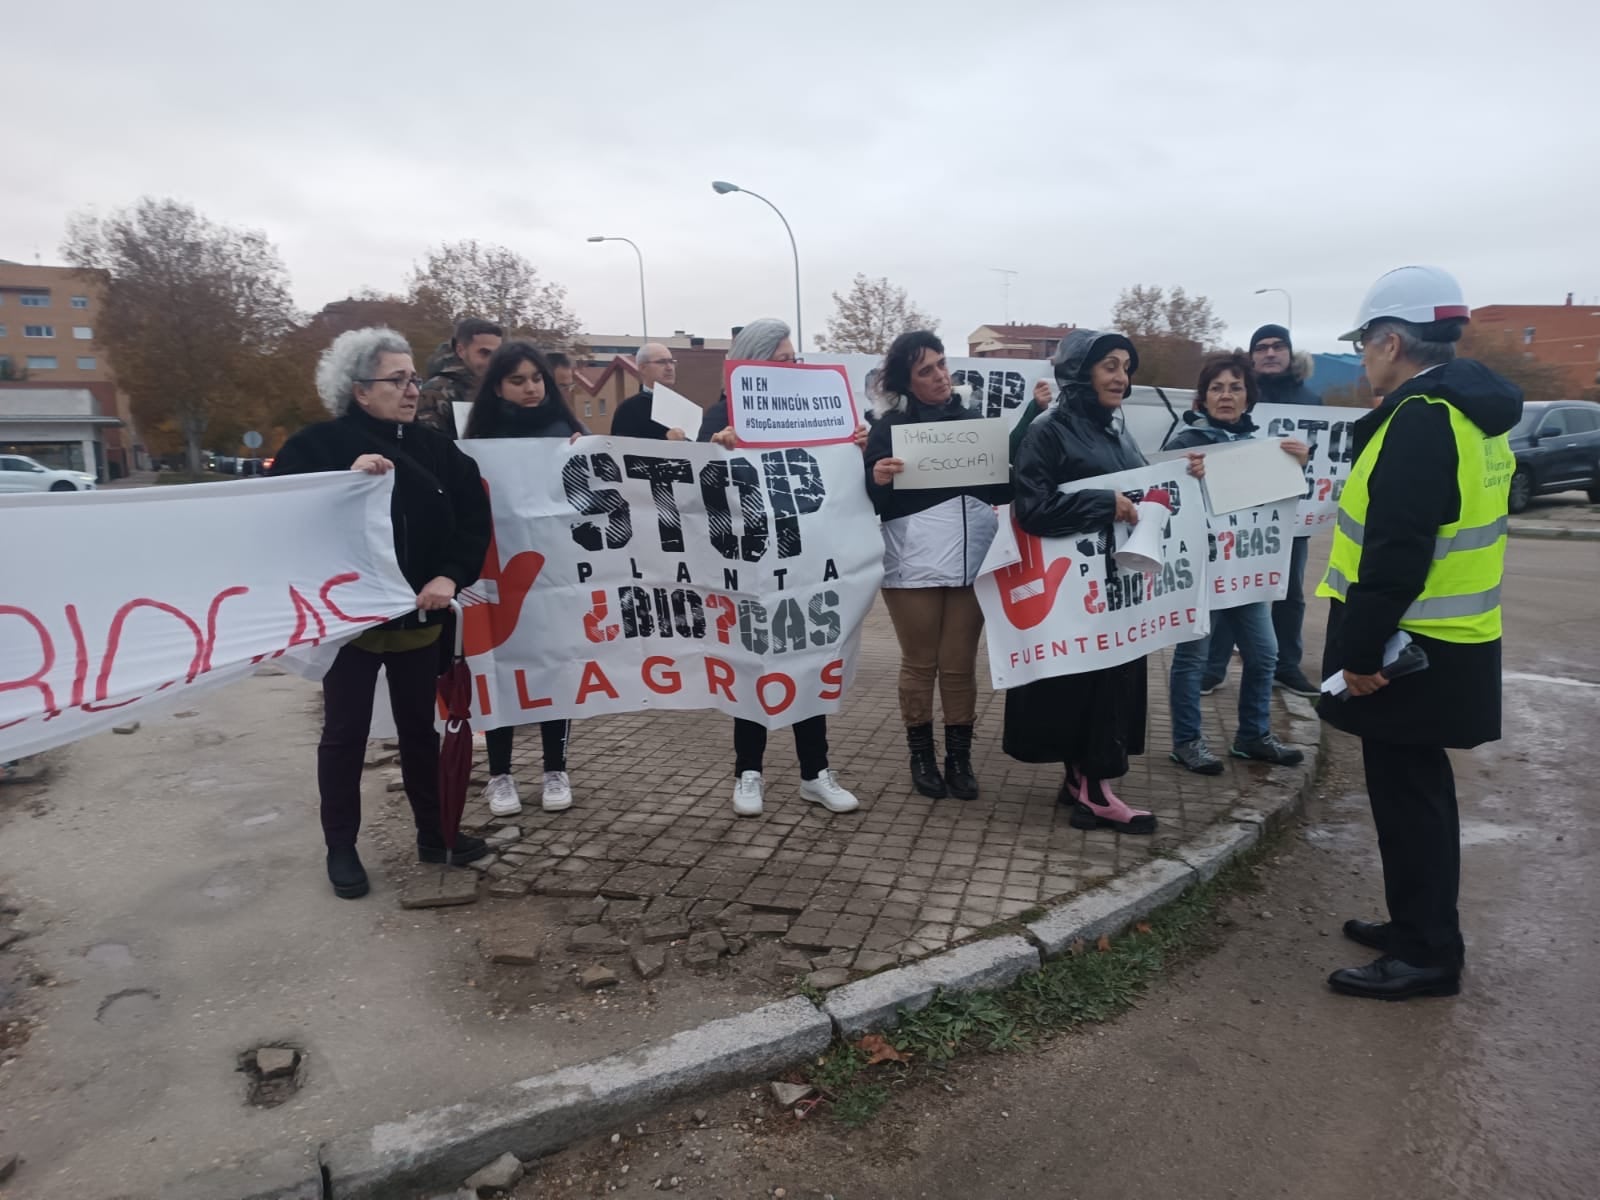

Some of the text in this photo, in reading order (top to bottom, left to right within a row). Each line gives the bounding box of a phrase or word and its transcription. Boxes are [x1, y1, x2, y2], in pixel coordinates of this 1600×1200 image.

[741, 377, 768, 392] NI EN
[743, 393, 842, 411] NI EN NINGÚN SITIO
[917, 452, 996, 473] ESCUCHA!
[561, 448, 826, 562] STOP
[577, 558, 839, 591] PLANTA
[438, 655, 843, 720] ILAGROS
